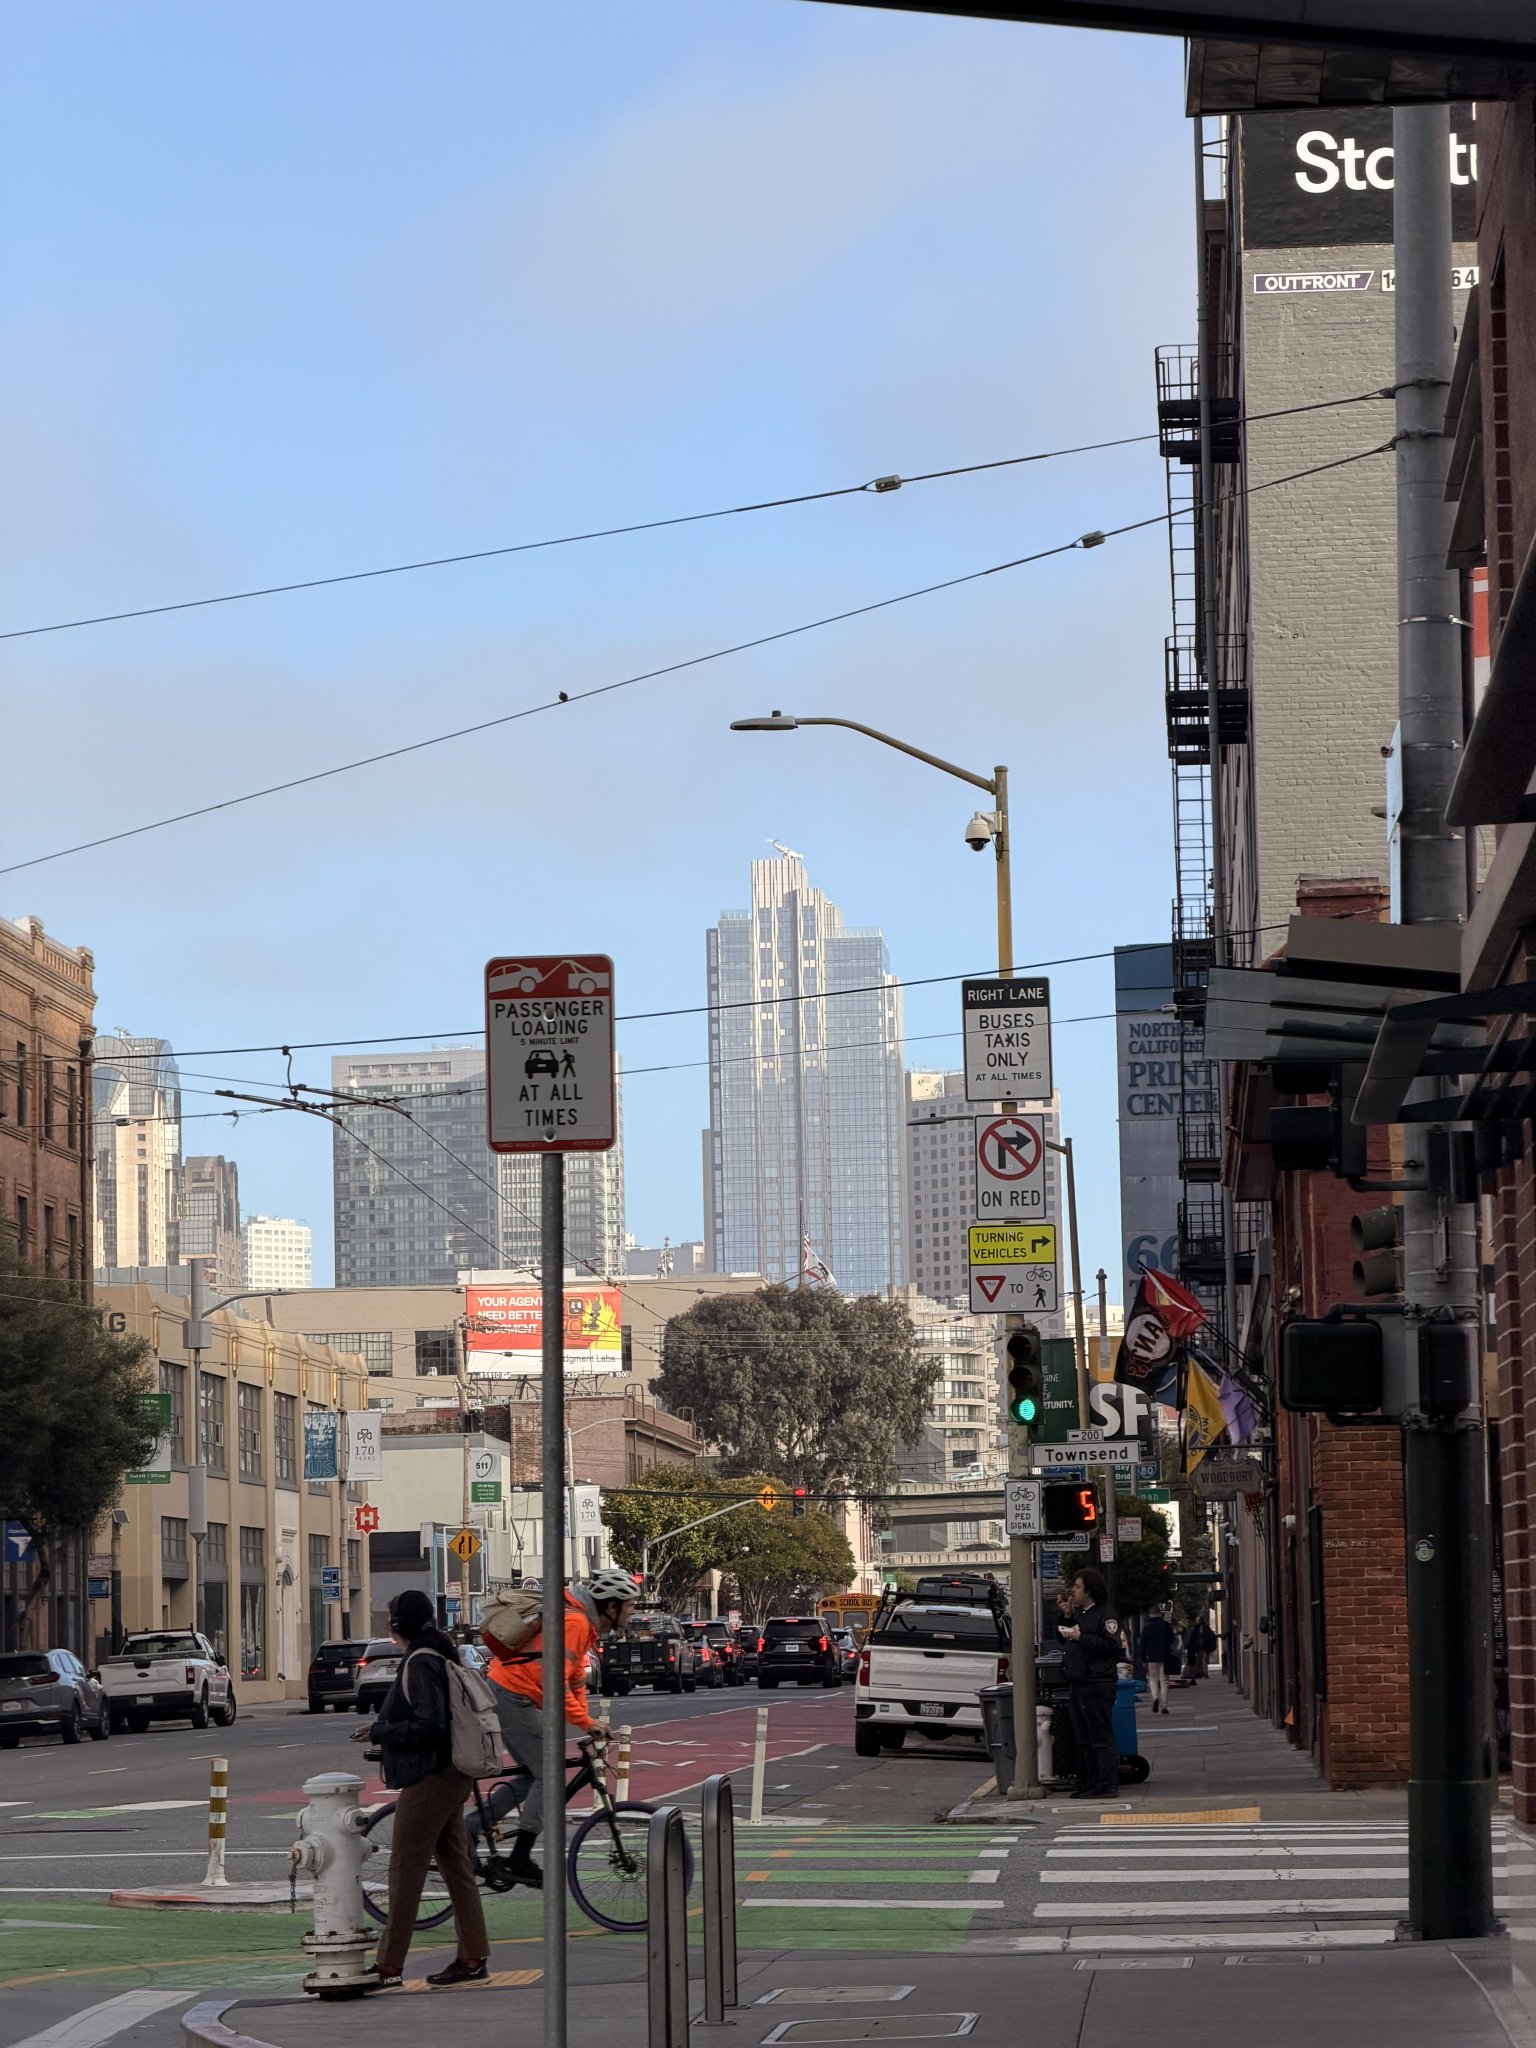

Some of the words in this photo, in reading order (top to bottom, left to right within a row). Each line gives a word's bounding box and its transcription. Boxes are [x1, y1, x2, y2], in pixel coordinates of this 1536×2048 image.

[1265, 273, 1360, 290] OUTFRONT
[968, 989, 1004, 1001] RIGHT
[1010, 988, 1044, 1000] LANE
[495, 1000, 604, 1018] PASSENGER
[980, 1013, 1034, 1029] BUSES
[512, 1019, 588, 1036] LOADING
[520, 1038, 526, 1046] 5
[529, 1038, 557, 1046] MINUTE
[560, 1036, 580, 1044] LIMIT
[984, 1033, 1030, 1048] TAXIS
[986, 1052, 1029, 1067] ONLY
[975, 1073, 987, 1081] AT
[991, 1073, 1008, 1081] ALL
[1012, 1072, 1042, 1080] TIMES
[1128, 1061, 1216, 1087] PRINT
[519, 1084, 539, 1102] AT
[550, 1083, 583, 1101] ALL
[1127, 1091, 1218, 1116] CENTER
[525, 1108, 578, 1126] TIMES
[981, 1191, 1002, 1207] ON
[1010, 1190, 1041, 1206] RED
[975, 1231, 1024, 1243] TURNING
[974, 1247, 1027, 1259] VEHICLES
[1010, 1283, 1024, 1294] TO
[477, 1297, 507, 1307] YOUR
[510, 1296, 543, 1306] AGENT
[478, 1310, 506, 1320] NEED
[508, 1310, 543, 1320] BETTE
[1043, 1400, 1075, 1409] TUNITY.
[1090, 1383, 1149, 1438] SF
[1081, 1432, 1099, 1440] 200
[355, 1445, 375, 1456] 170
[1045, 1446, 1128, 1462] Townsend
[476, 1462, 488, 1470] 511
[1141, 1467, 1154, 1475] 80
[1201, 1471, 1253, 1483] WOODBURY
[1015, 1503, 1031, 1511] USE
[1079, 1490, 1096, 1521] 5
[360, 1512, 374, 1526] H
[1015, 1512, 1031, 1520] PED
[1010, 1522, 1036, 1530] SIGNAL
[840, 1598, 861, 1606] SCHOOL
[862, 1598, 872, 1606] BUS
